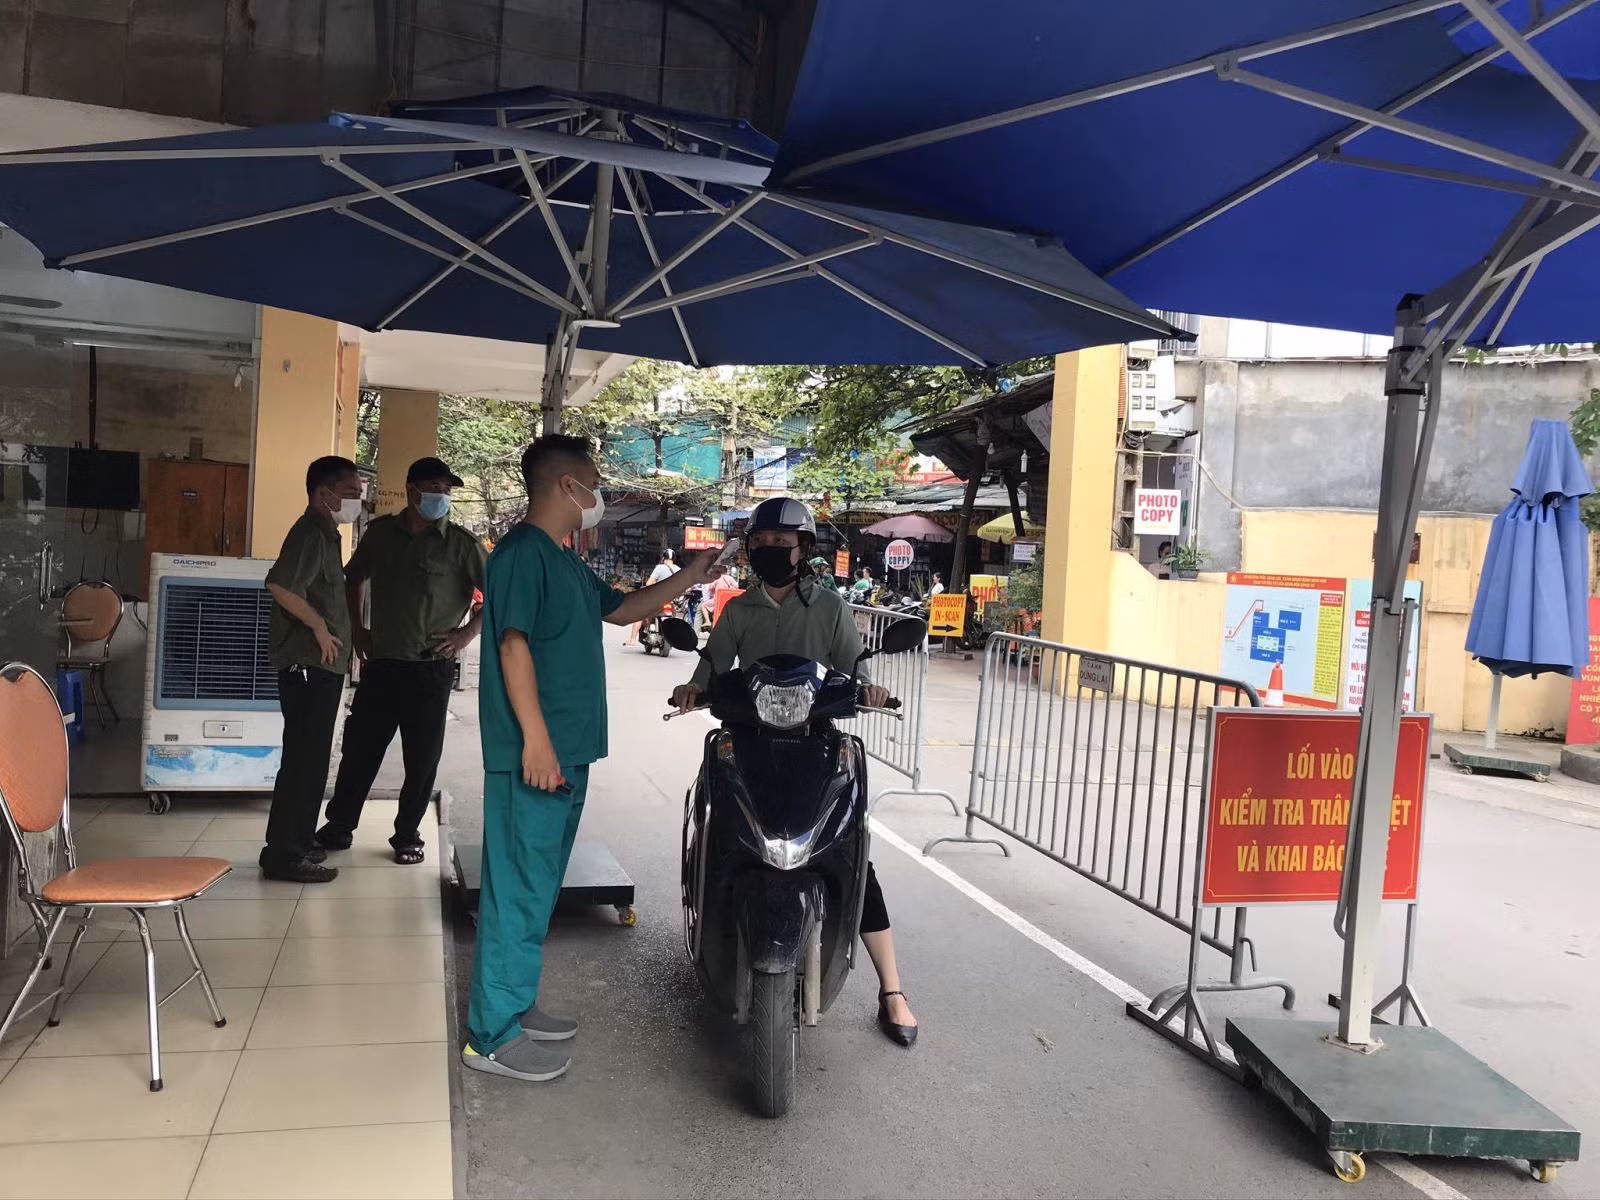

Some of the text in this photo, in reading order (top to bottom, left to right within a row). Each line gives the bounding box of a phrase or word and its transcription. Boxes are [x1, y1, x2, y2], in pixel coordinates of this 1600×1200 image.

[1138, 494, 1179, 508] PHOTO
[1141, 508, 1174, 522] COPY
[888, 545, 911, 556] PHOTO
[888, 555, 911, 565] COPPY
[1287, 742, 1354, 780] LỐI VÀO
[1219, 787, 1268, 826] KIỂM
[1272, 799, 1305, 826] TRA
[1237, 840, 1260, 872] VÀ
[1265, 845, 1309, 872] KHAI
